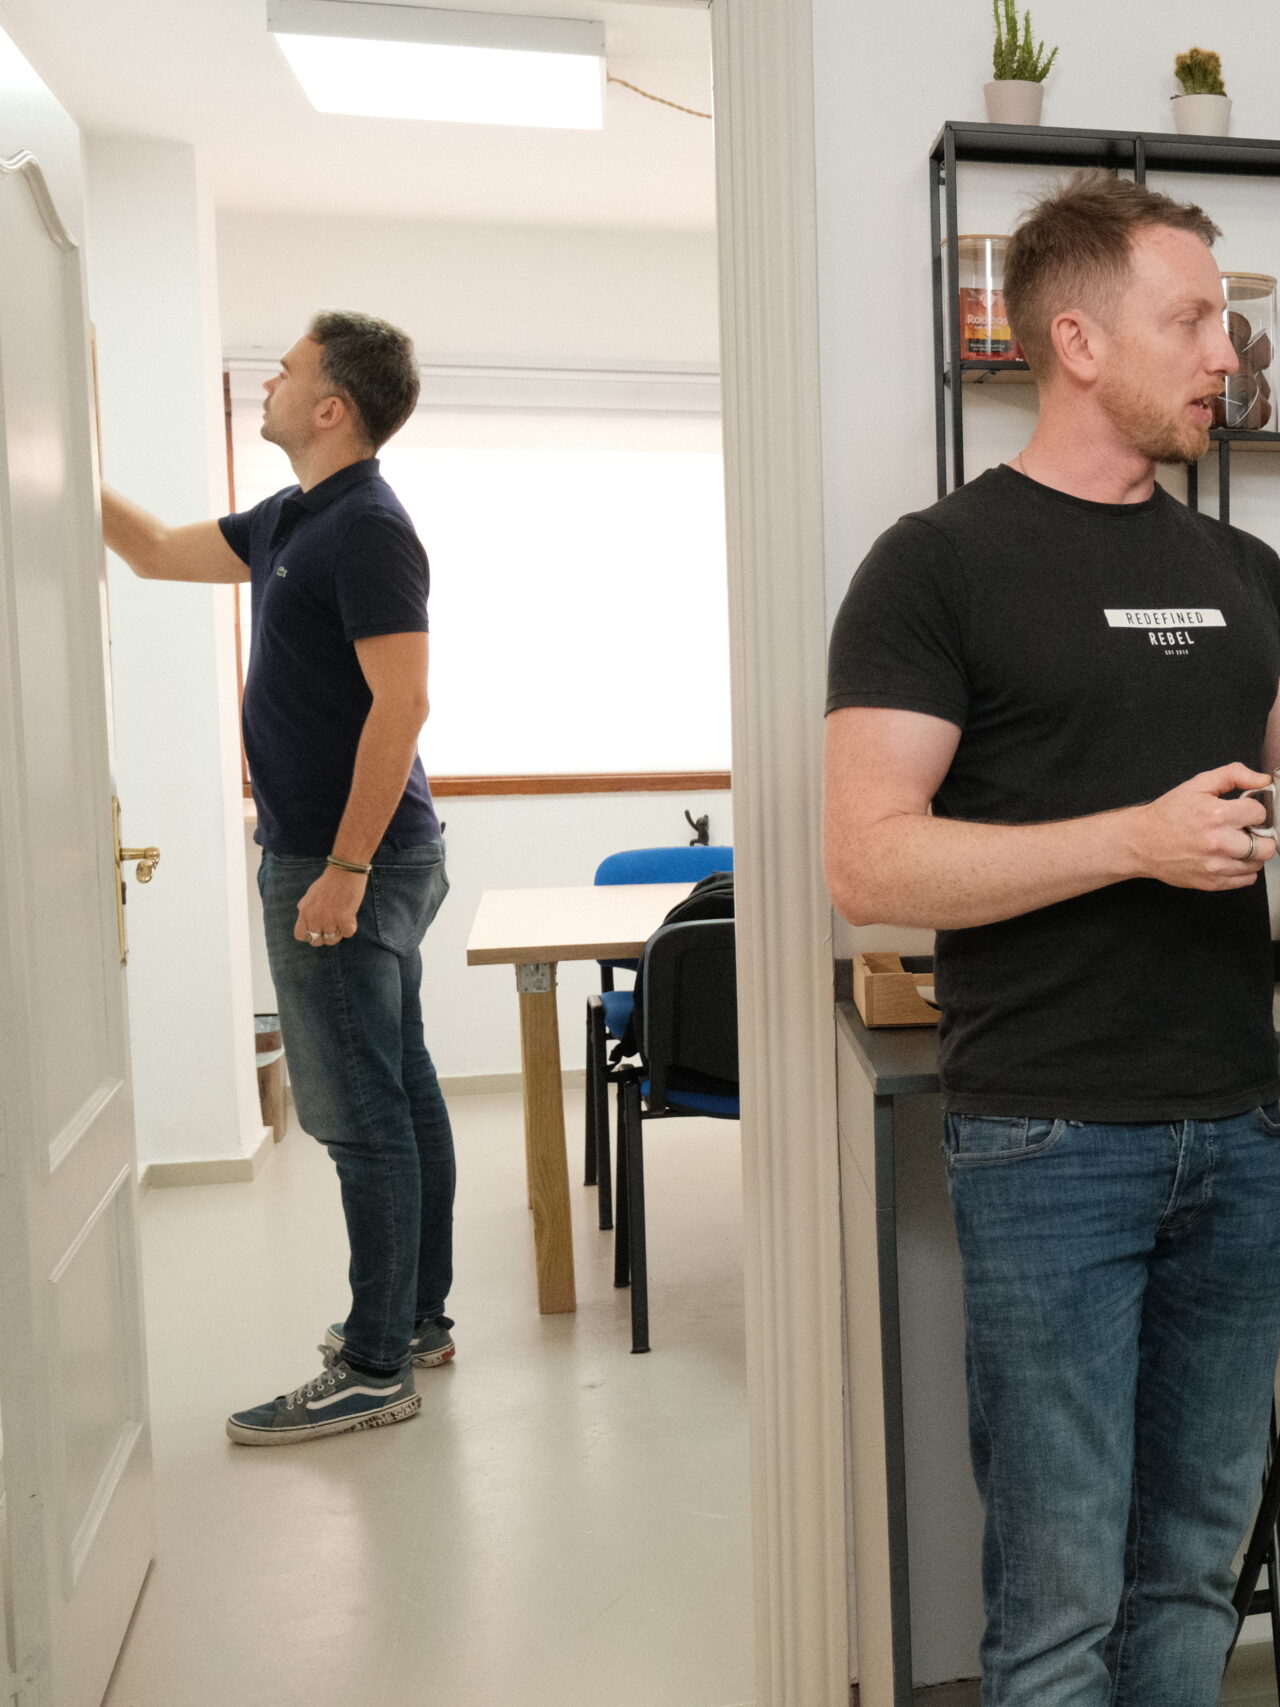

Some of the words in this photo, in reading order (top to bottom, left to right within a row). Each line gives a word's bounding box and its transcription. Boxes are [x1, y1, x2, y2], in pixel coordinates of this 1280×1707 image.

[967, 314, 1008, 325] Rooos
[1125, 611, 1204, 625] REDEFINED
[1148, 631, 1195, 646] REBEL
